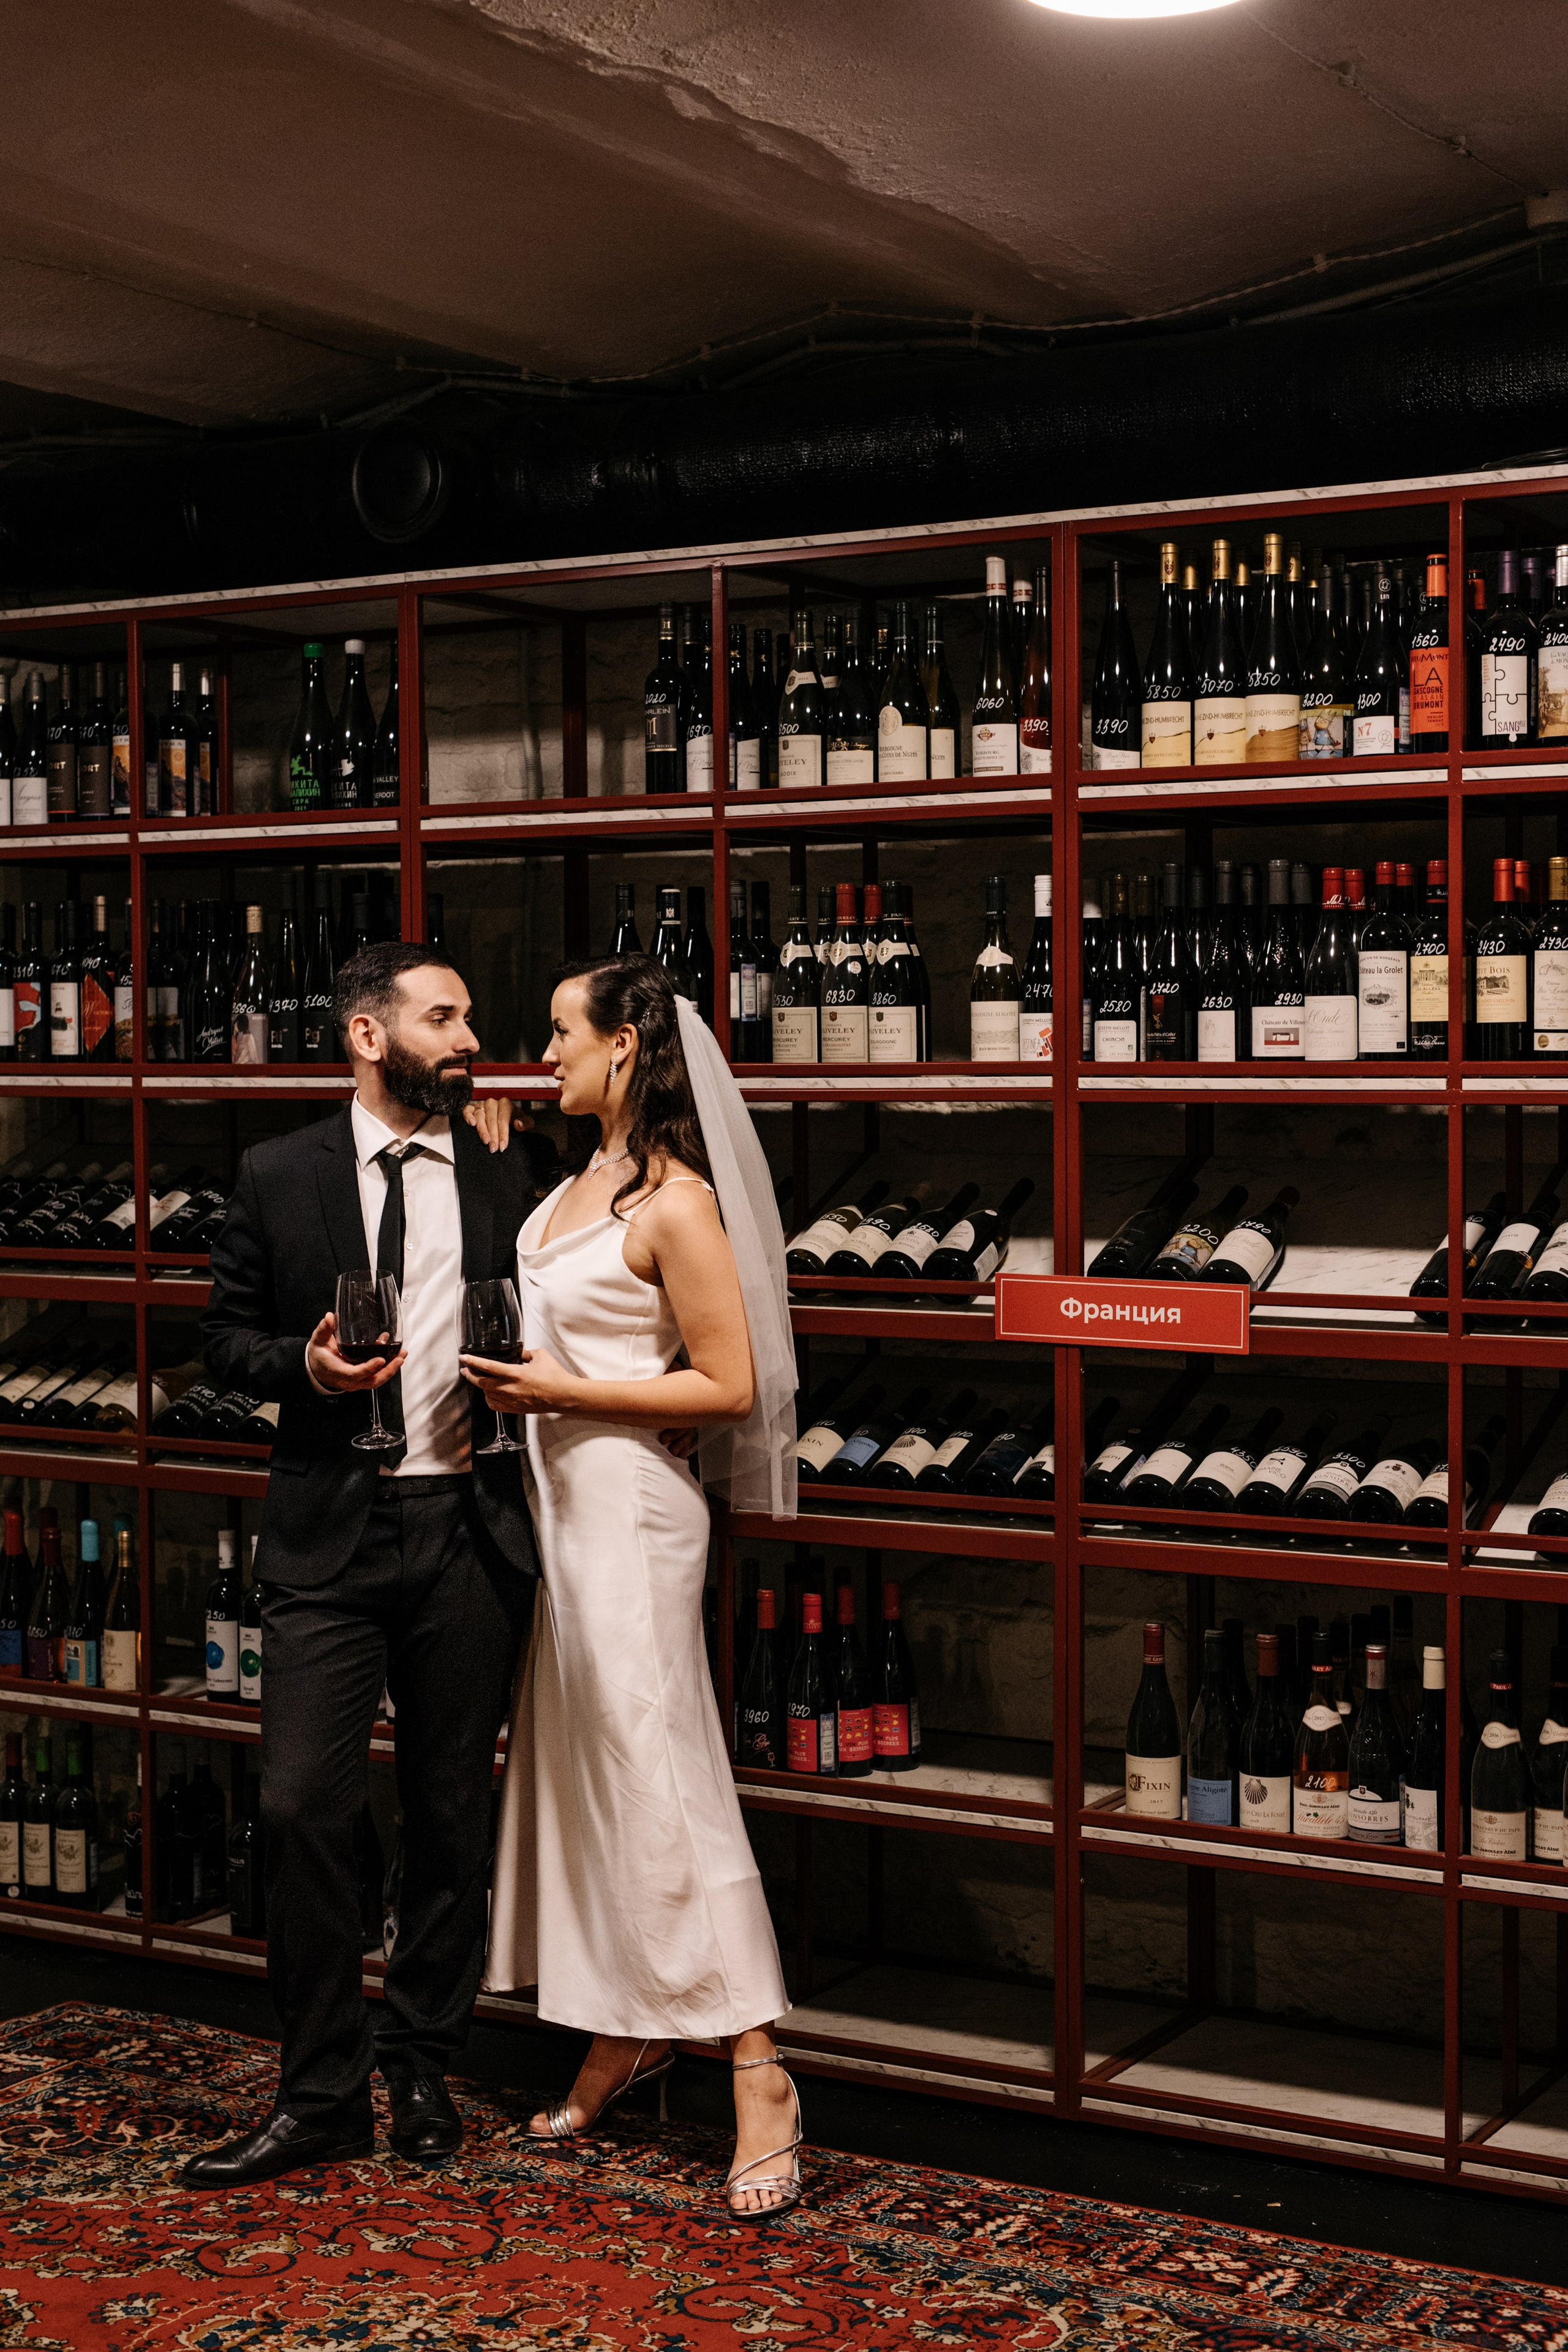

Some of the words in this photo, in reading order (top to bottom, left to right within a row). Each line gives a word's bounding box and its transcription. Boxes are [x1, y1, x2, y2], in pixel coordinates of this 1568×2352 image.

[1411, 633, 1439, 649] 1560
[1489, 637, 1525, 652] 2490
[1248, 673, 1281, 687] 5850
[1413, 667, 1443, 687] LA
[1147, 684, 1182, 699] 5850
[1200, 679, 1234, 694] 5070
[1413, 686, 1444, 695] GASCOGNE
[976, 697, 1005, 711] 6060
[1302, 693, 1333, 707] 3200
[1357, 693, 1381, 710] 1300
[1413, 700, 1444, 710] BRUMONT
[1023, 718, 1049, 733] 3390
[1096, 718, 1128, 735] 3390
[1498, 721, 1520, 733] SANG
[1414, 943, 1446, 957] 2700
[1384, 966, 1403, 974] Grolet
[1149, 982, 1180, 995] 2720
[826, 989, 855, 1004] 6830
[872, 992, 897, 1005] 3860
[1202, 995, 1232, 1009] 2630
[1274, 992, 1303, 1006] 2930
[268, 998, 298, 1012] 4370
[1099, 1000, 1131, 1014] 2580
[1181, 1224, 1219, 1245] 3200
[1060, 1297, 1181, 1325] Франция
[1230, 1446, 1257, 1469] 4350
[1332, 1452, 1366, 1469] 3300
[744, 1708, 769, 1724] 3960
[1137, 1776, 1170, 1790] FIXIN
[1305, 1775, 1336, 1789] 2100
[1202, 1786, 1227, 1795] Aligoté
